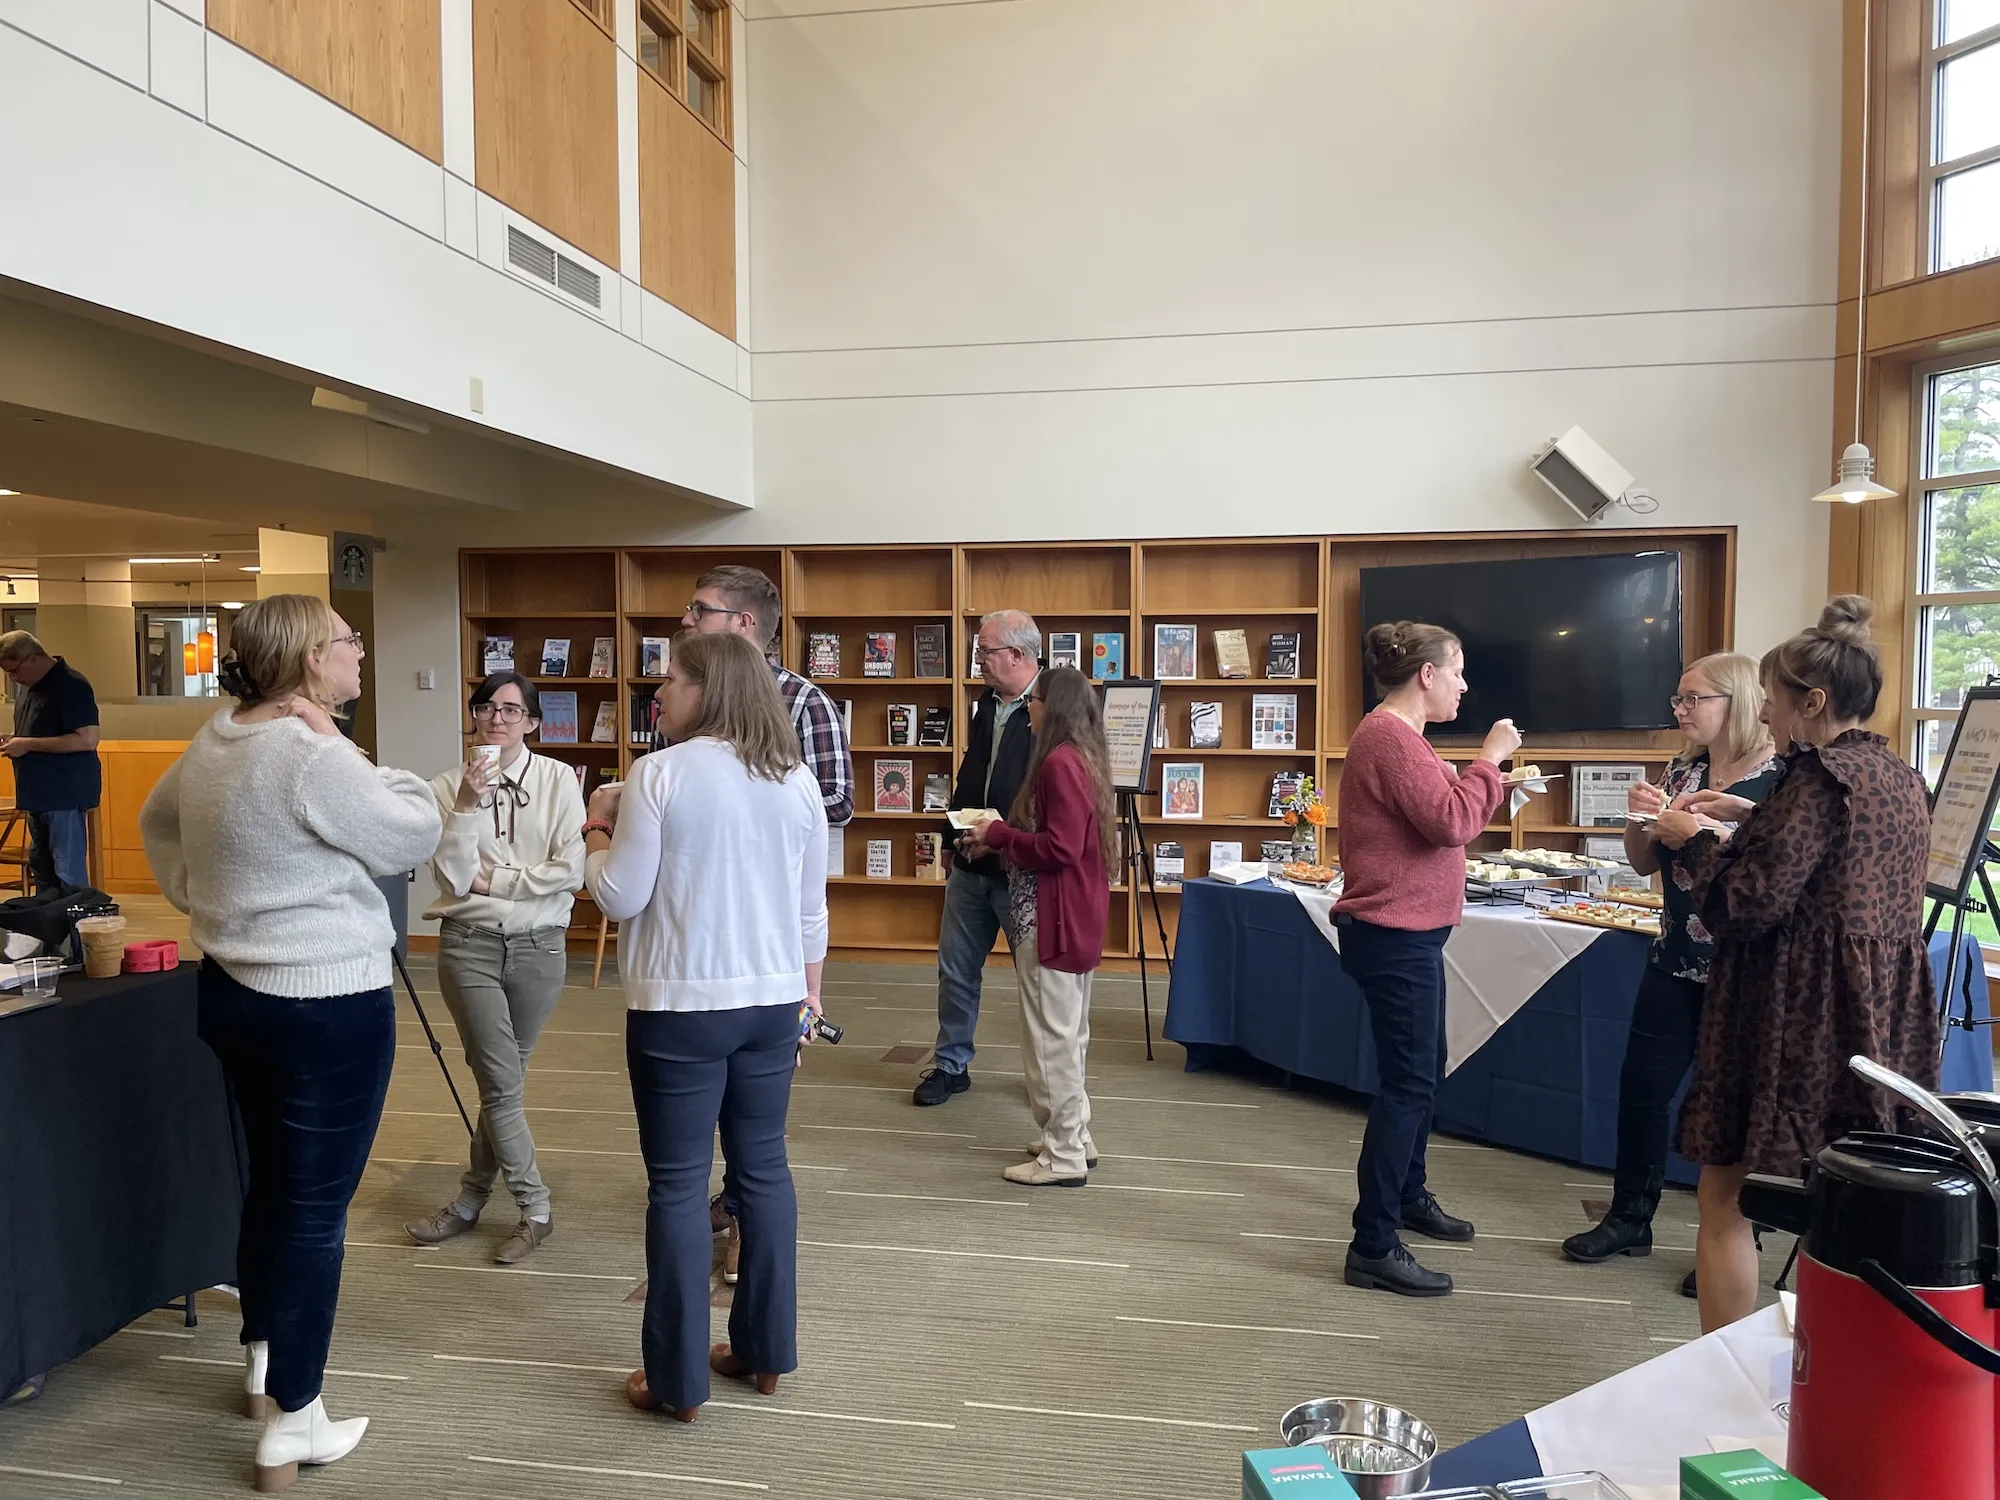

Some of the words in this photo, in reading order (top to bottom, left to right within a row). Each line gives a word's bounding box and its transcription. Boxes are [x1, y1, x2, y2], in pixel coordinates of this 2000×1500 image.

[864, 661, 892, 670] UNBOUND
[1167, 769, 1200, 778] JUSTICE
[1272, 1472, 1335, 1484] TEAVANA
[1727, 1474, 1789, 1486] TEAVANA
